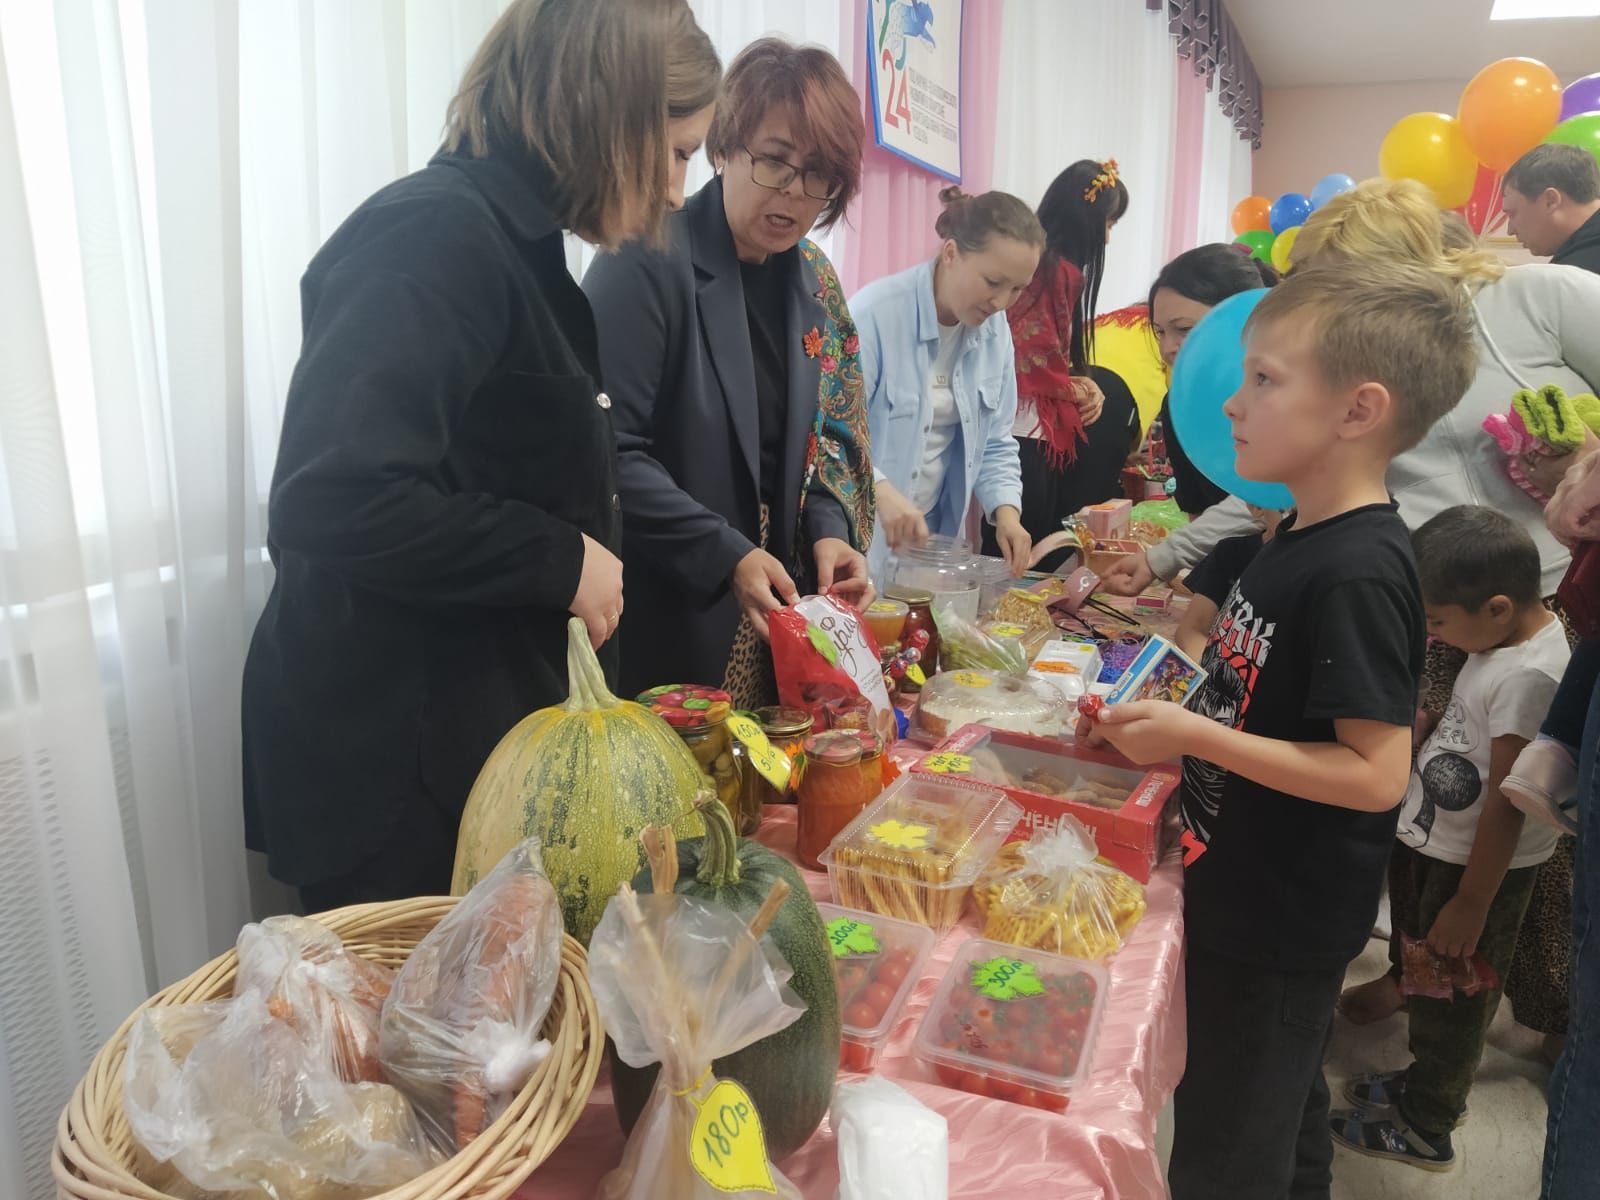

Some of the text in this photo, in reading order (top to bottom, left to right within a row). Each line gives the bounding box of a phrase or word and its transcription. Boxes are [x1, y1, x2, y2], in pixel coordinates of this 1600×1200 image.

[882, 48, 911, 135] 24
[988, 961, 1022, 988] 300р
[703, 1102, 749, 1169] 180р
